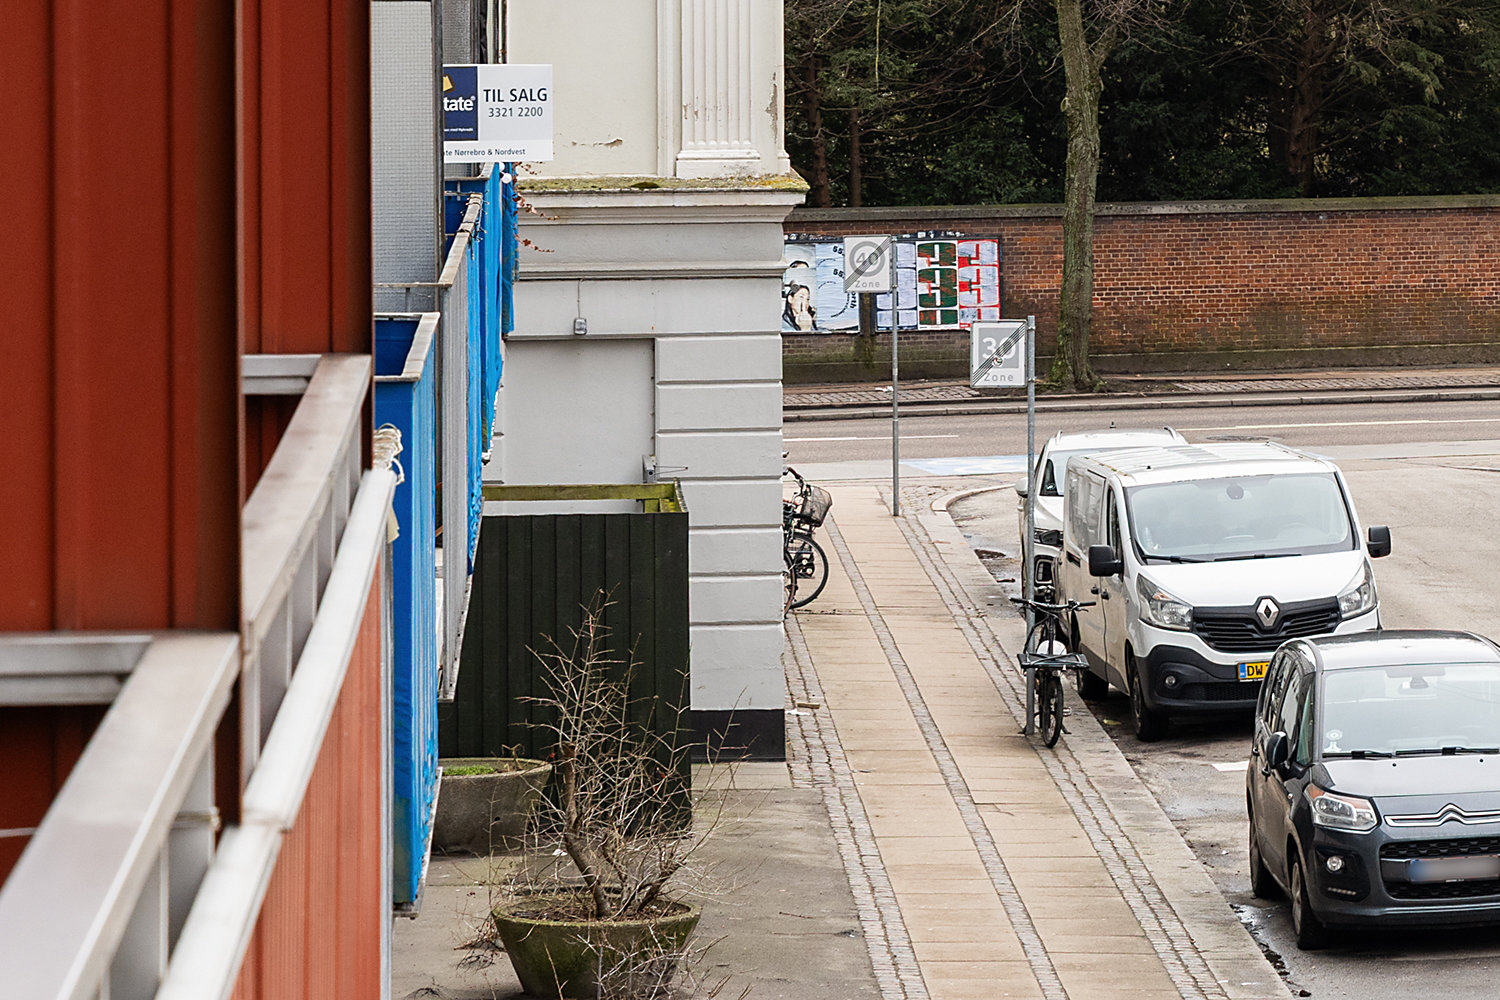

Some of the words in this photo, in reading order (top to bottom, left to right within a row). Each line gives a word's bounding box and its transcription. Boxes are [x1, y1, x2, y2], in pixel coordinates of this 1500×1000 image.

[483, 89, 504, 102] TIL
[509, 88, 547, 102] SALG
[488, 107, 513, 117] 3321
[518, 107, 543, 117] 2200
[856, 252, 878, 265] 40
[982, 337, 1016, 360] 30
[984, 373, 1014, 381] Zone
[1247, 665, 1263, 676] DW
